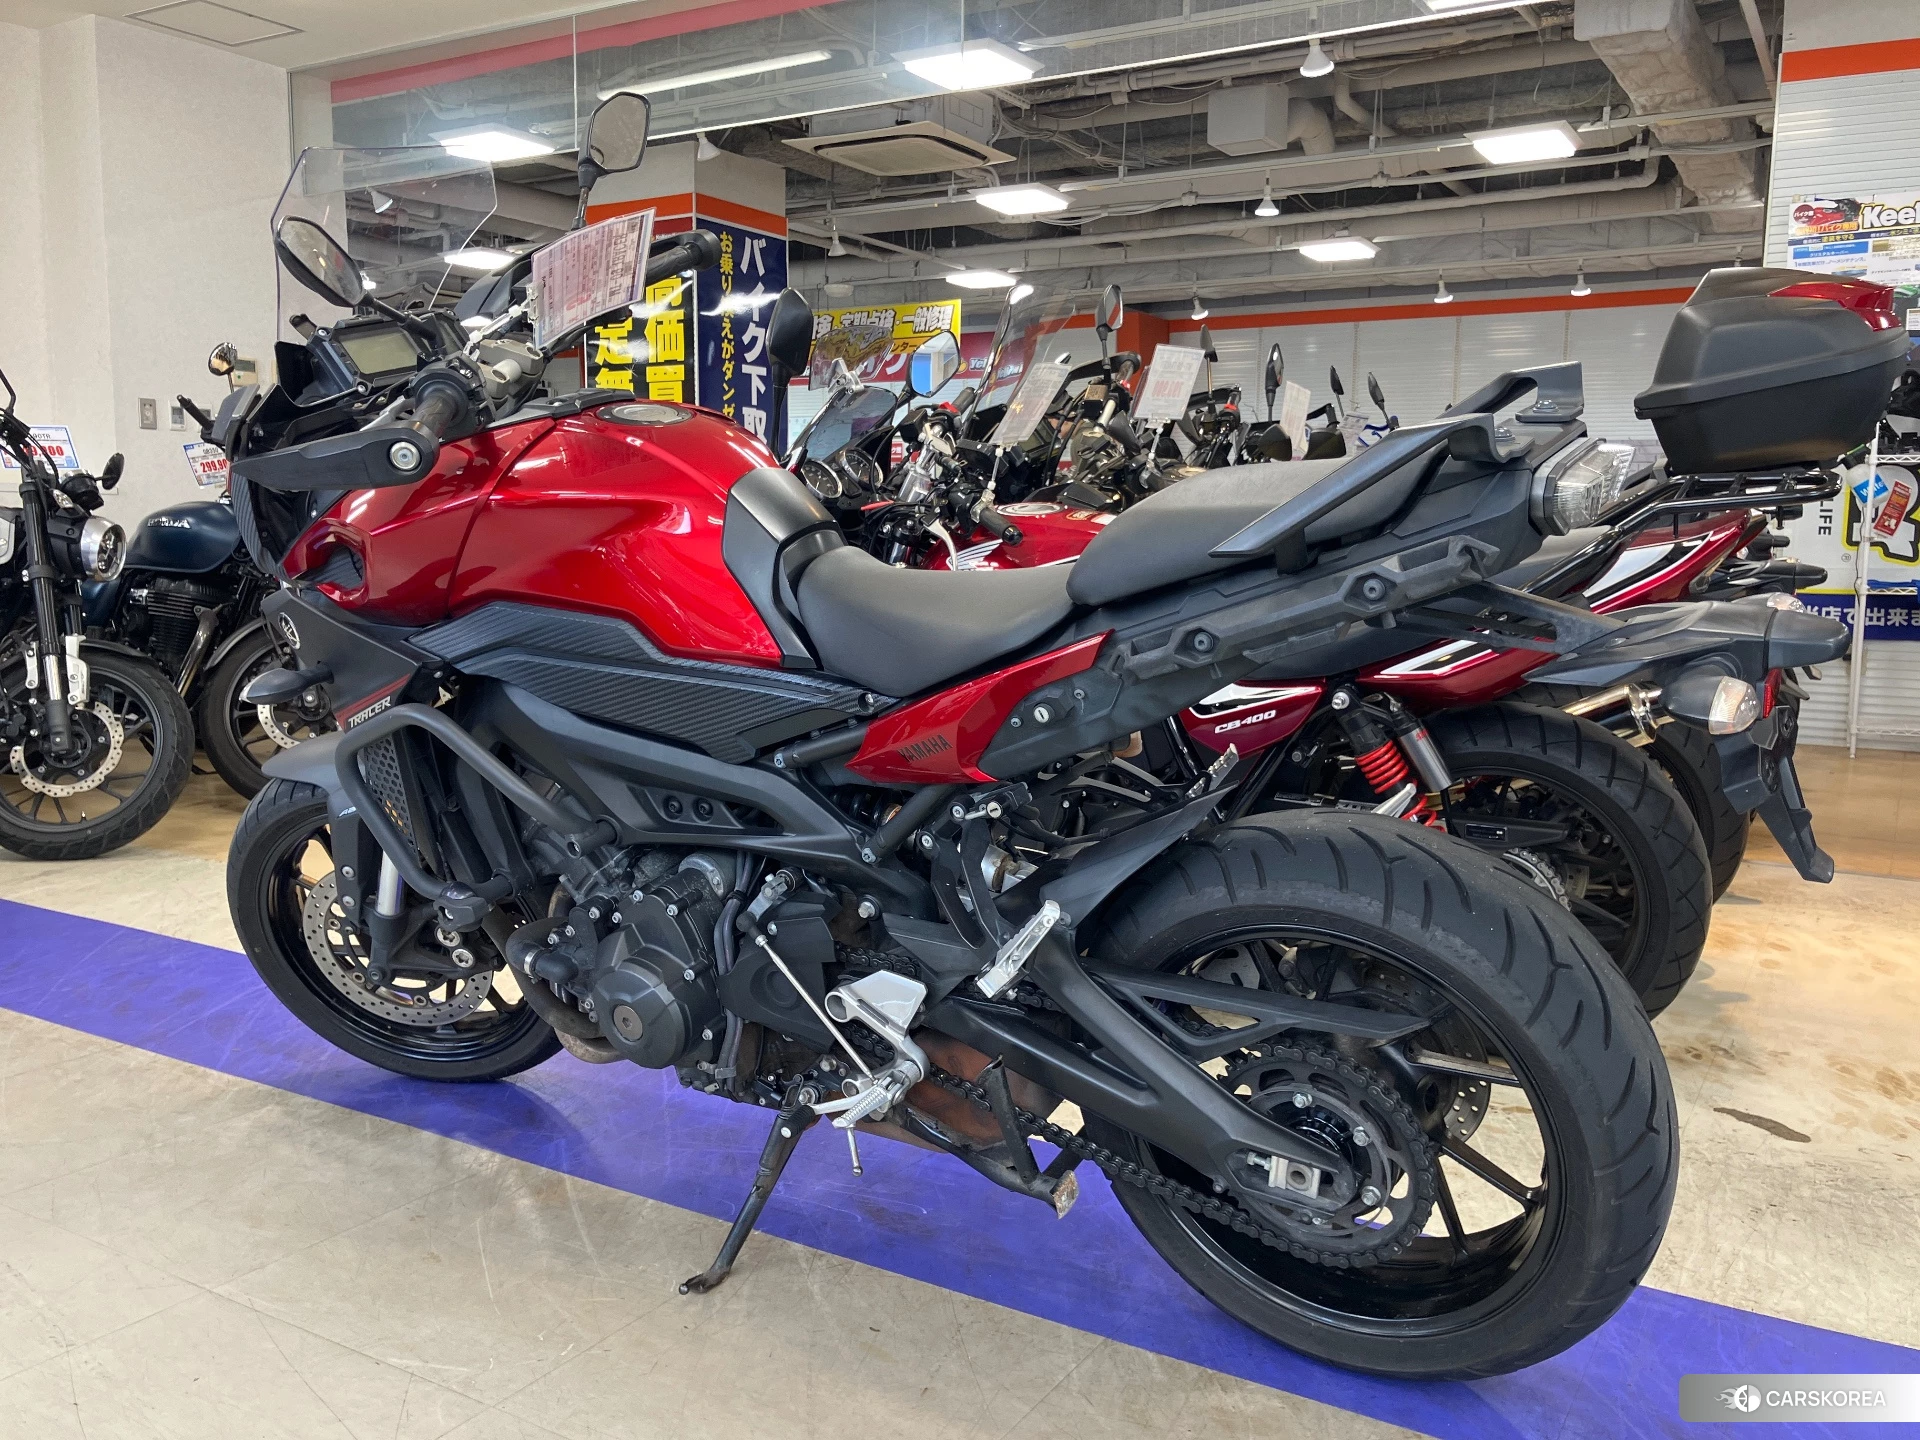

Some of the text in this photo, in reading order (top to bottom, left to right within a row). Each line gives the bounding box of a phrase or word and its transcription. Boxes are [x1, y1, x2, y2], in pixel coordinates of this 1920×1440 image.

[719, 231, 736, 417] お乗りえがダンゼ
[200, 458, 228, 473] 299,90
[1818, 499, 1834, 536] LIFE
[348, 695, 391, 728] TRACER
[1214, 710, 1277, 734] CB400
[897, 734, 953, 762] YAMAHA
